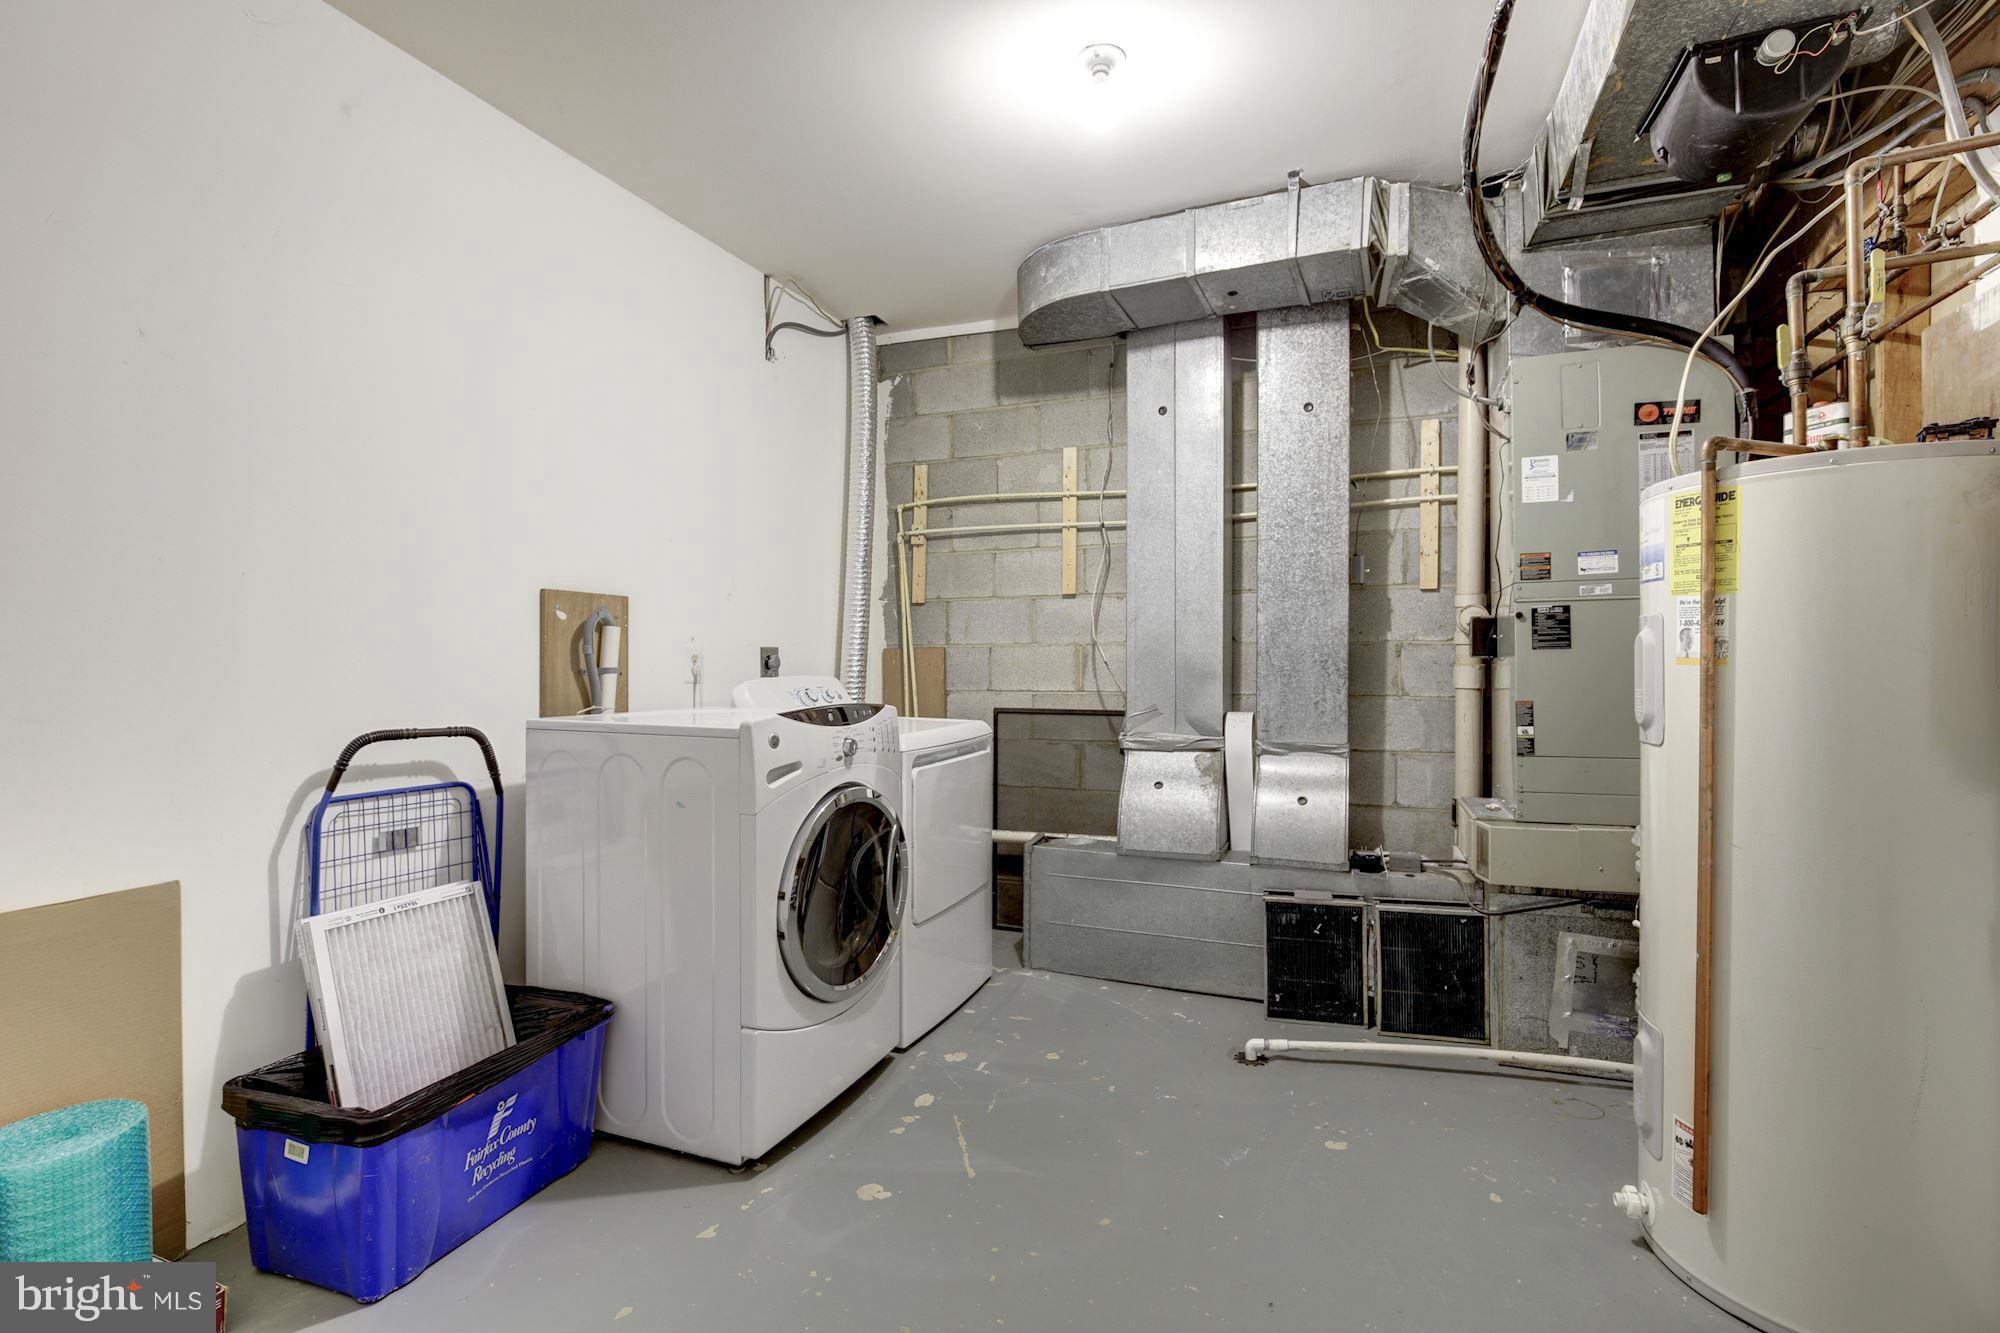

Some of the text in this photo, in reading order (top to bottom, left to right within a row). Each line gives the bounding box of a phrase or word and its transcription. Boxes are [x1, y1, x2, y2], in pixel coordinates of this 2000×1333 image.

[464, 1116, 537, 1172] Fairfax County
[471, 1146, 517, 1187] Recycling
